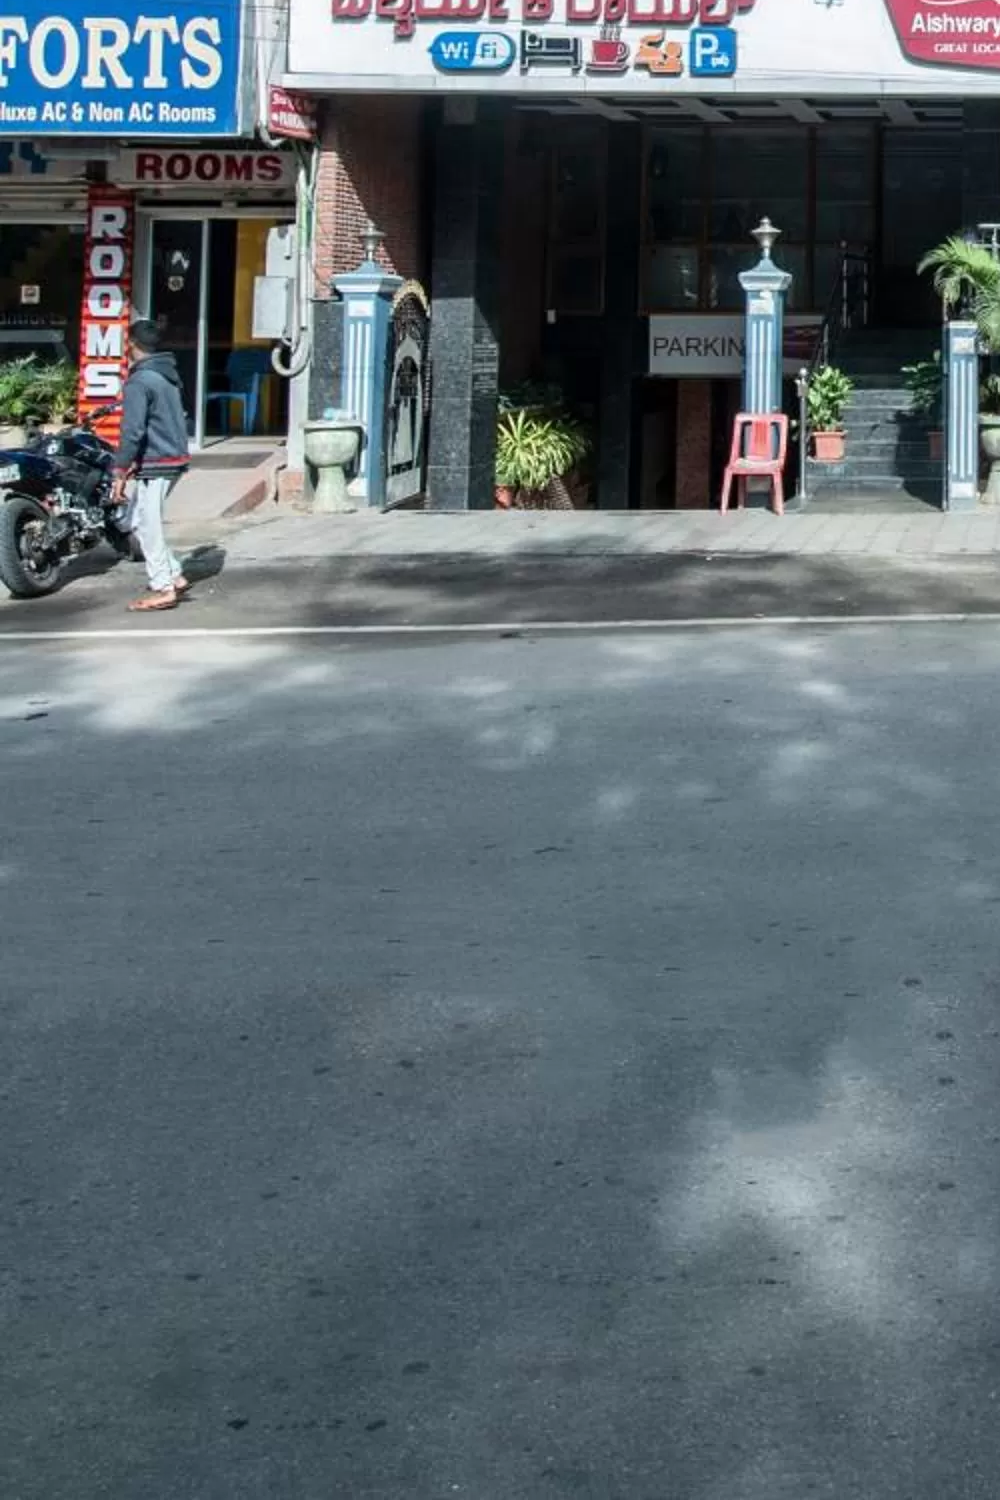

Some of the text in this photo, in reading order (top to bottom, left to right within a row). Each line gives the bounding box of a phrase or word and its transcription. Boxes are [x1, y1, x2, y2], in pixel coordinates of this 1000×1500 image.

[0, 16, 223, 89] FORTS
[933, 43, 968, 53] GREAT
[0, 101, 217, 123] luxe AC & Non AC Rooms
[136, 153, 283, 181] ROOMS
[84, 206, 127, 396] ROOMS
[653, 336, 746, 357] PARKIN
